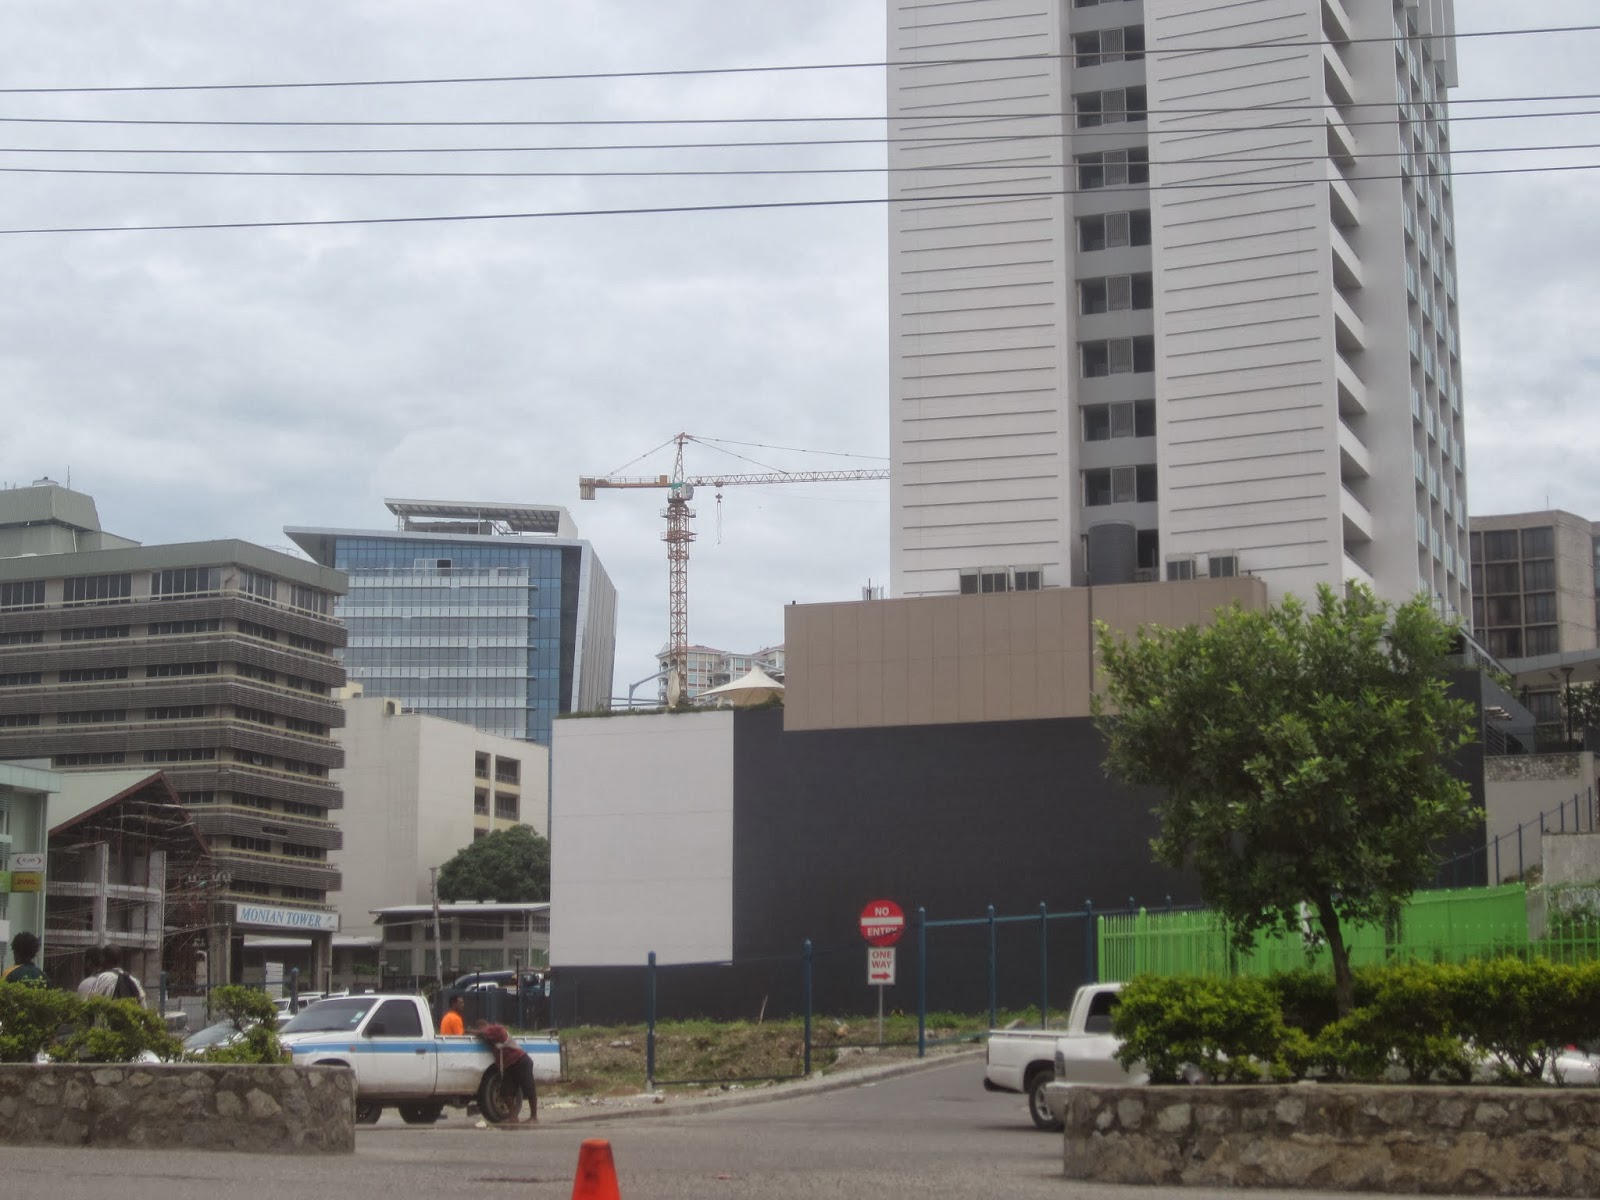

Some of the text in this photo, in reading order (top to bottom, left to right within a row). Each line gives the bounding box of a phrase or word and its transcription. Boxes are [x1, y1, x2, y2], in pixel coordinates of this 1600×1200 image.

[875, 907, 890, 916] NO
[241, 908, 321, 928] MONIAN TOWER
[872, 951, 892, 959] ONE
[871, 961, 892, 969] WAY
